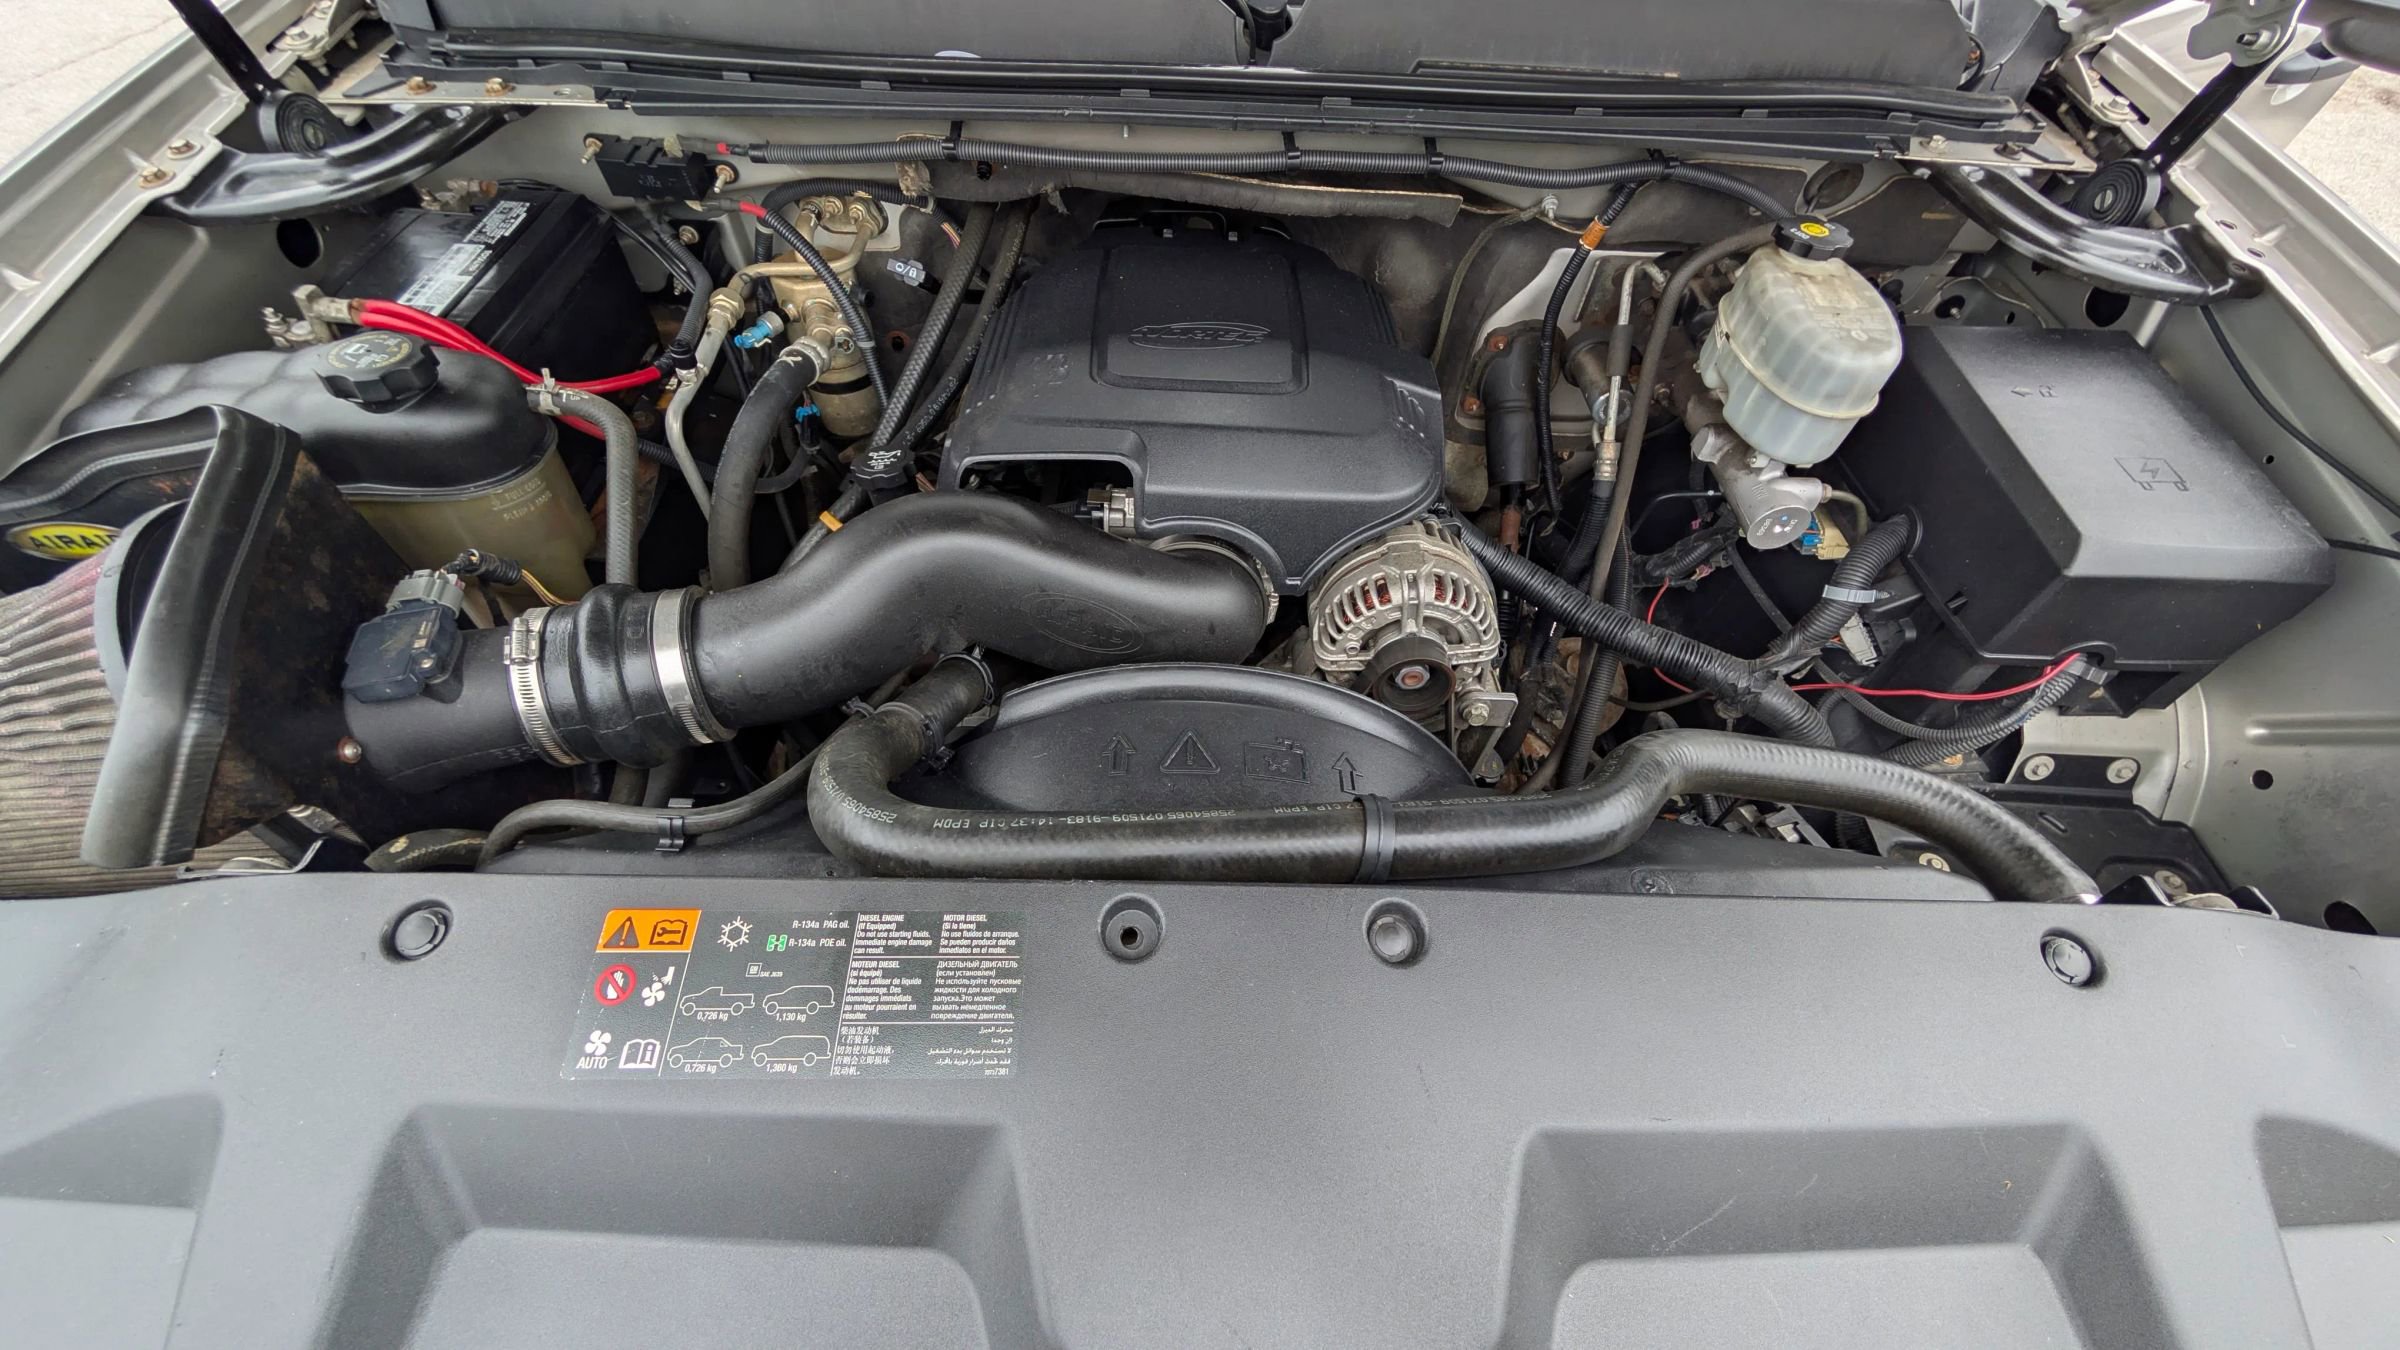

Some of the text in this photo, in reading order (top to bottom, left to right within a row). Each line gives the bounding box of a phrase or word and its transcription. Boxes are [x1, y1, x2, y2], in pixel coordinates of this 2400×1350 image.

[841, 797, 898, 823] 25854065
[932, 818, 970, 829] EPDM
[860, 914, 905, 922] DIESEL ENGINE
[943, 914, 988, 922] MOTOR DIESEL
[793, 920, 819, 929] R-134a
[823, 920, 837, 929] PAG
[889, 931, 912, 939] starting
[788, 938, 816, 947] R-134a
[820, 938, 834, 947] POE
[949, 939, 972, 947] pueden
[972, 939, 997, 947] producir
[851, 960, 900, 968] MOTEUR DIESEL
[936, 960, 1018, 969] ДИЗЕЛЬНЫЙ ДВИГАТЕЛЬ
[848, 977, 858, 985] Ne
[858, 978, 870, 986] pas
[892, 977, 901, 985] de
[901, 977, 922, 986] liquide
[889, 986, 902, 994] Des
[697, 1012, 729, 1022] 0,726 kg
[776, 1012, 807, 1023] 1,130 kg
[576, 1057, 608, 1069] AUTO
[684, 1064, 717, 1074] 0,726 kg
[790, 1064, 798, 1074] kg
